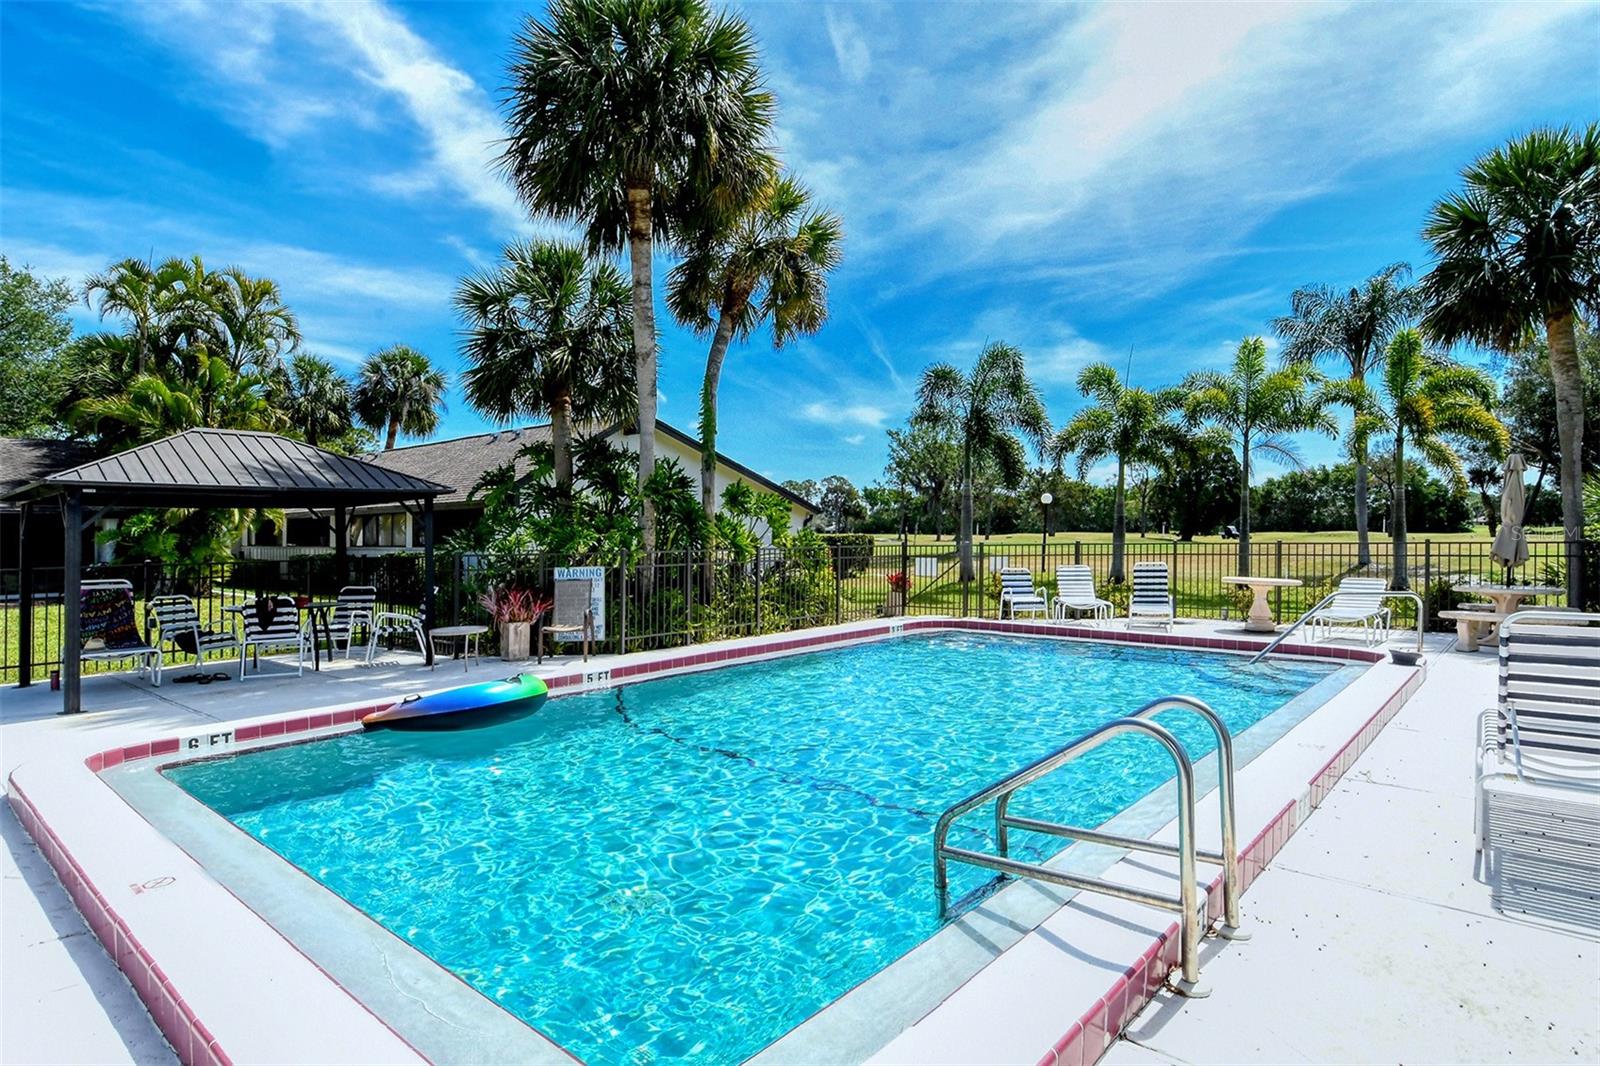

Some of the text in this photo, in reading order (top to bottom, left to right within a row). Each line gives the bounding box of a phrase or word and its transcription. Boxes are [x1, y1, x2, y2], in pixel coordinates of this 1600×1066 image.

[557, 568, 602, 578] WARNING
[587, 670, 609, 683] 5 FT
[188, 732, 232, 749] 6 FT
